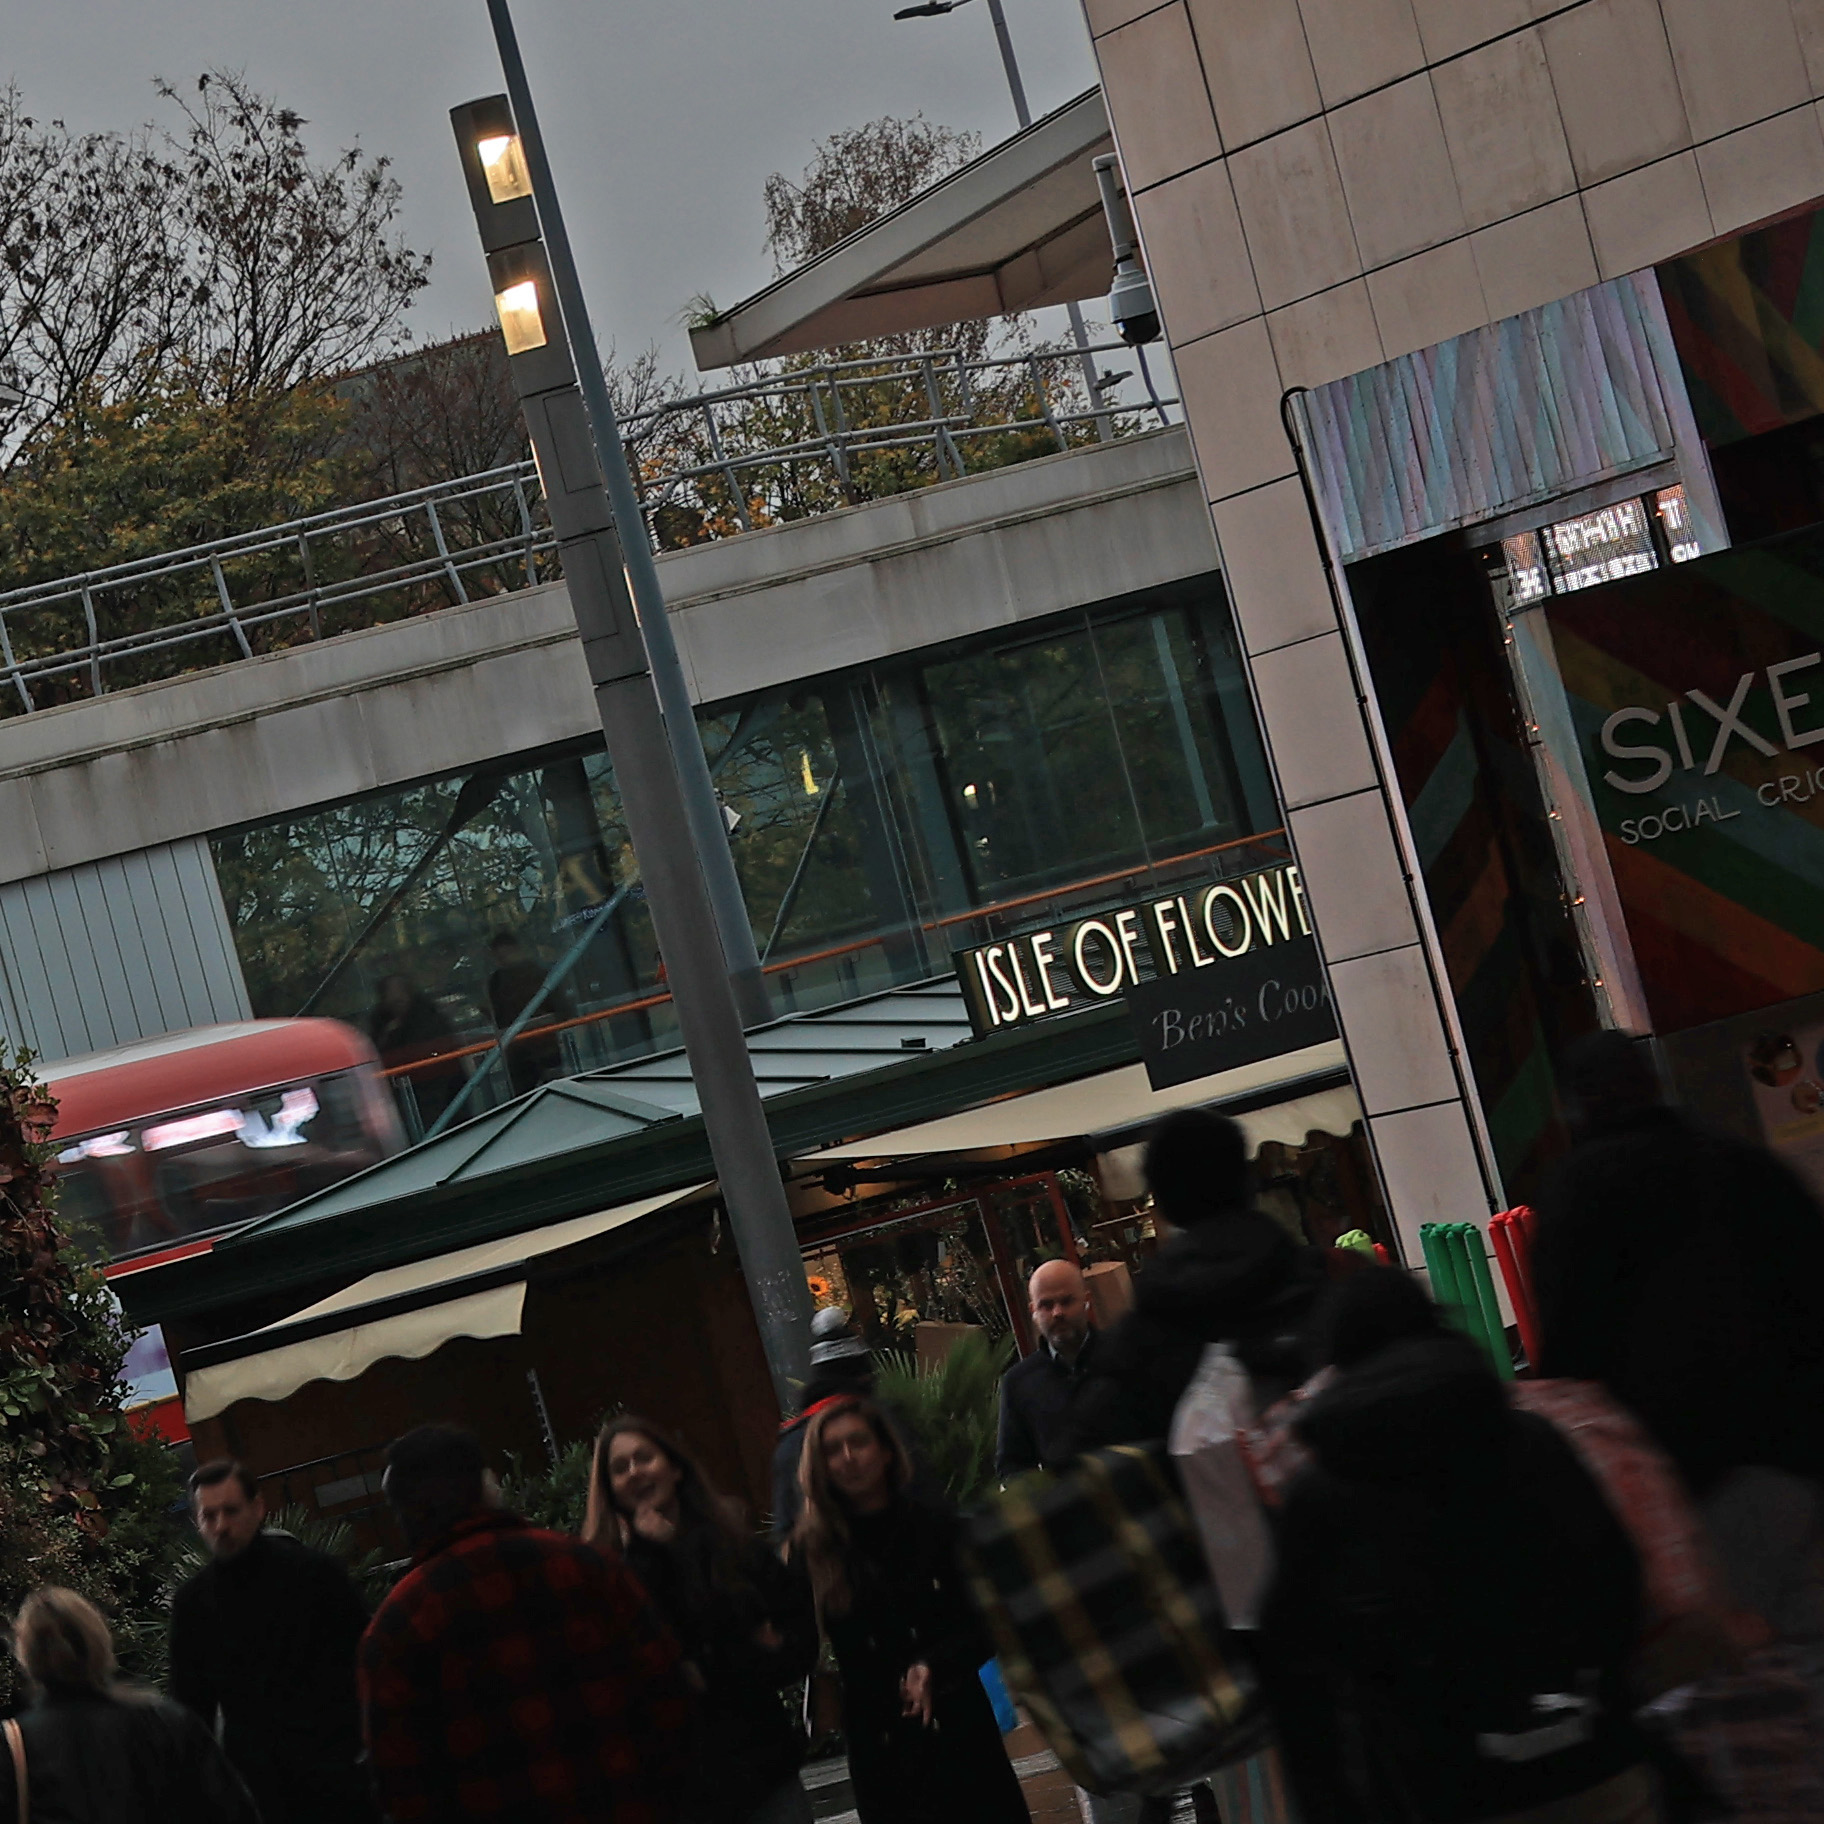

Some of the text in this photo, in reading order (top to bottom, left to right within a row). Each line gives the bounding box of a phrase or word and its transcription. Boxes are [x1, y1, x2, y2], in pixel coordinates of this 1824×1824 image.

[1601, 651, 1824, 794] SIXE
[1620, 797, 1741, 845] SOCIAL
[975, 931, 1070, 1027] ISLE
[1073, 909, 1140, 997] OF
[1153, 997, 1247, 1052] Ben's
